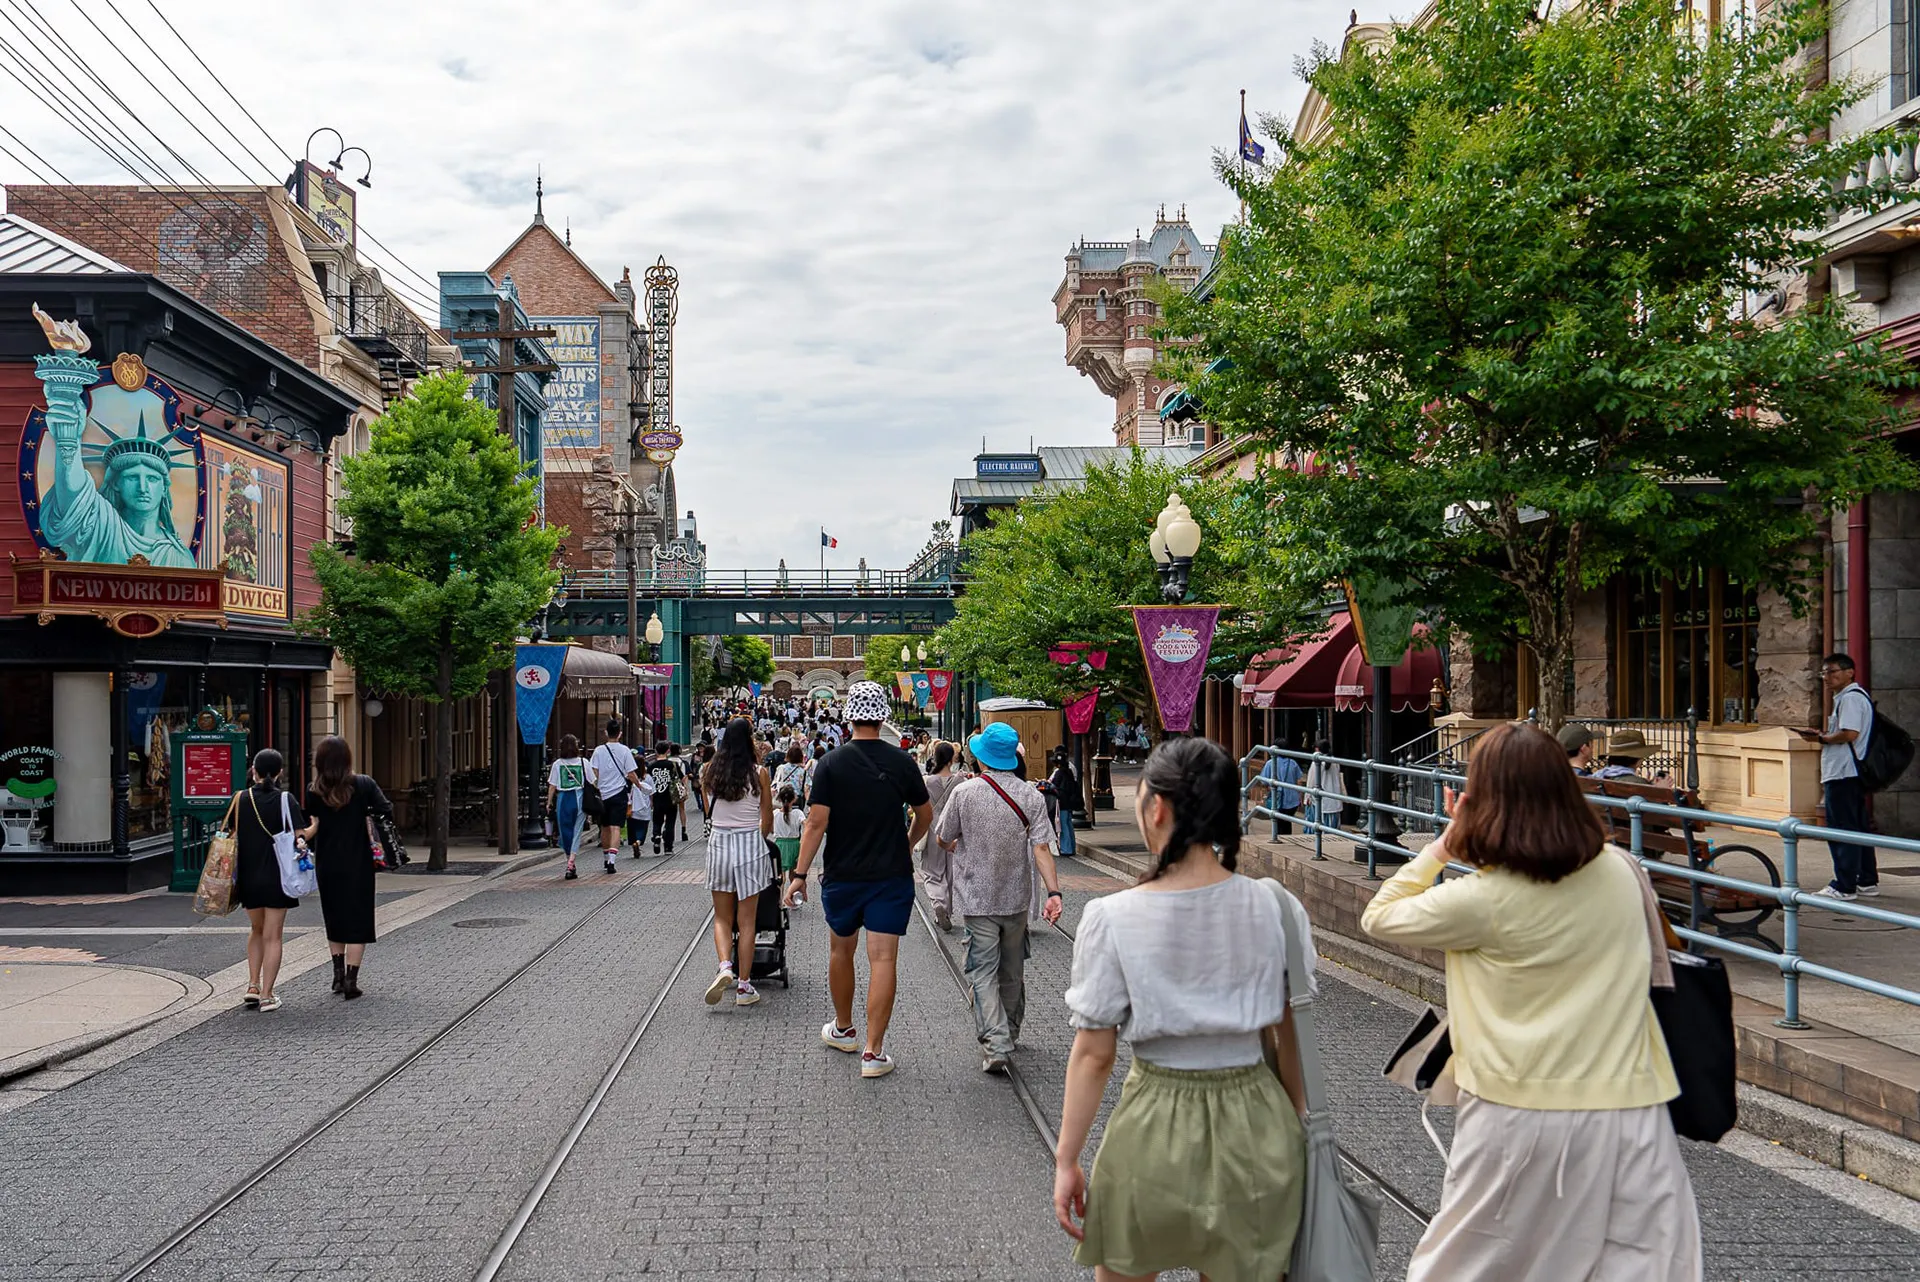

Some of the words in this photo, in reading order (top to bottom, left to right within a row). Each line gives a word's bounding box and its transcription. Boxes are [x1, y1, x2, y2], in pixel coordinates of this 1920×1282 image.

[981, 462, 1009, 470] ELECTRIC
[1010, 462, 1035, 470] RAILWAY
[57, 578, 104, 598] NEW
[107, 580, 162, 601] YORK
[166, 583, 212, 602] DELI
[0, 746, 29, 761] WORLD
[31, 746, 64, 762] FAMOUS
